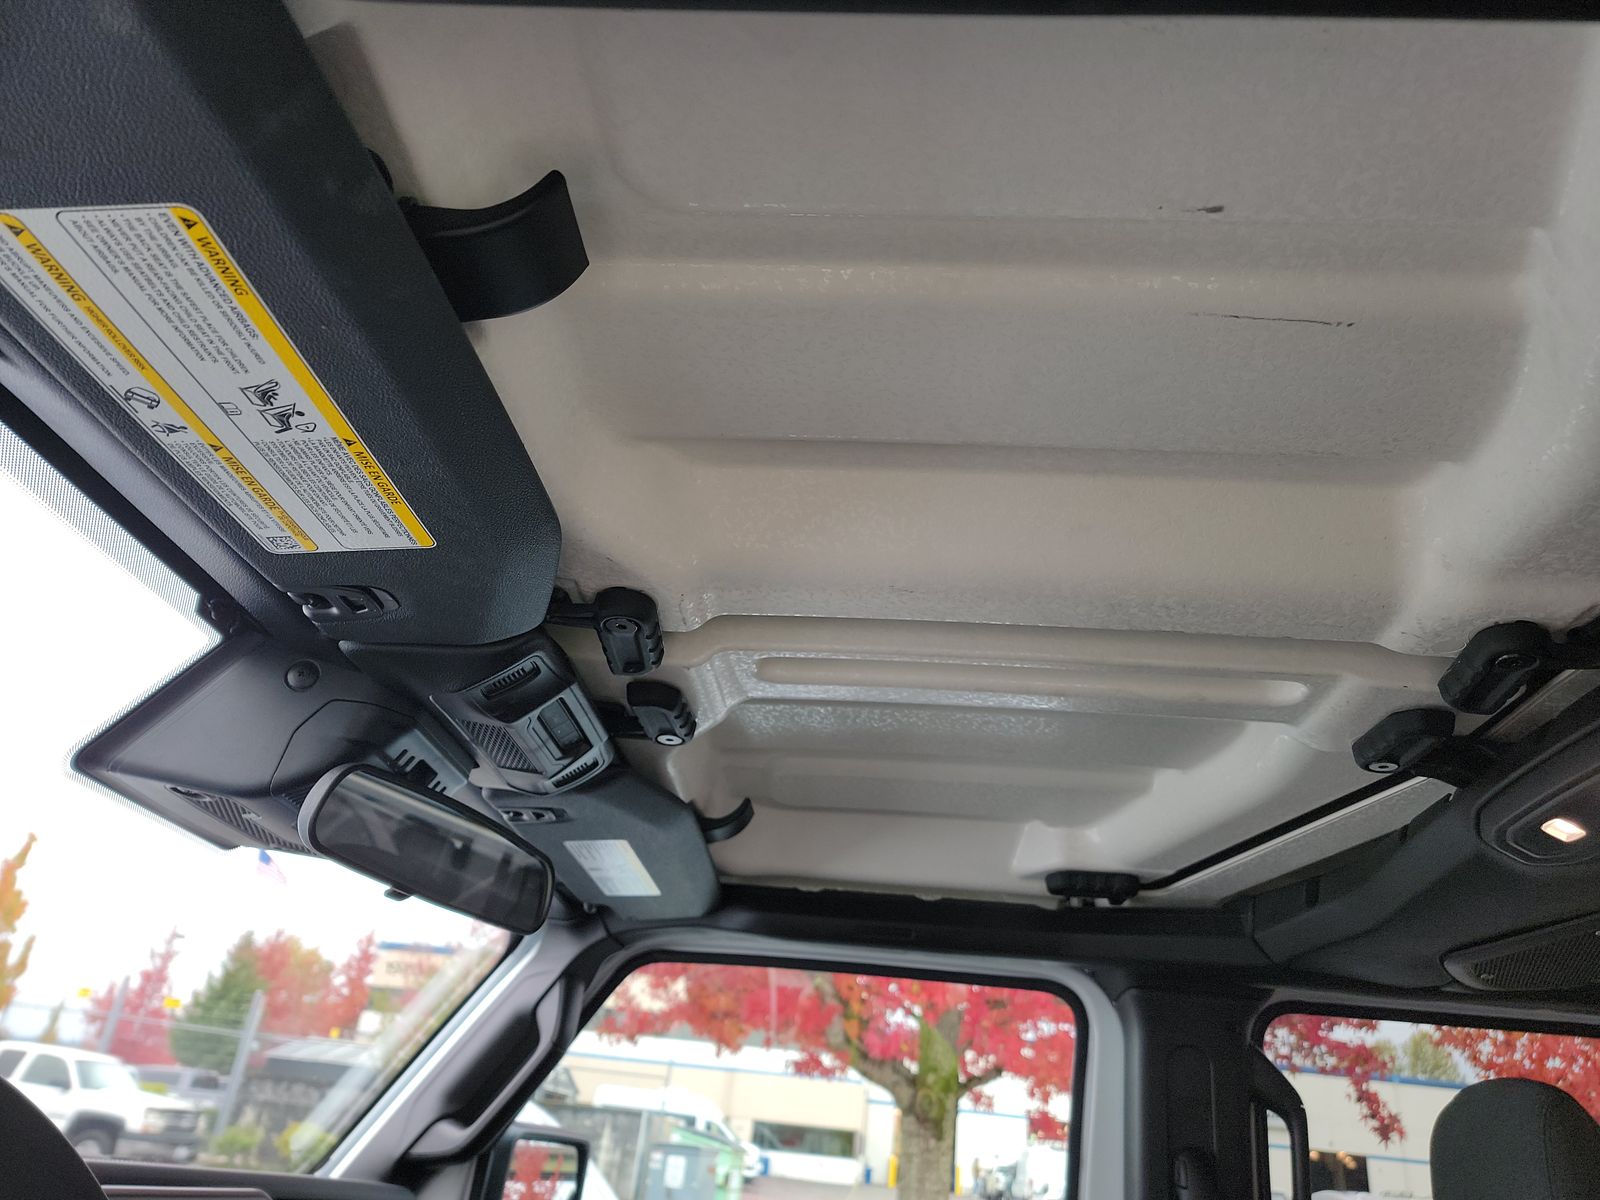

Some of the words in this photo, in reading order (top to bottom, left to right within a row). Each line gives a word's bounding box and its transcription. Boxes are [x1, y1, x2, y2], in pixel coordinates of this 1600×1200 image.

[68, 219, 95, 242] ABOUT
[132, 216, 147, 226] BY
[140, 227, 160, 241] THE
[155, 211, 183, 235] EVEN
[174, 235, 202, 260] WITH
[192, 260, 235, 304] ADVANCED
[0, 253, 33, 280] BUCKLE
[22, 242, 89, 301] WARNING
[81, 219, 100, 233] SEE
[120, 265, 149, 291] MANUAL
[142, 292, 161, 306] FOR
[154, 306, 176, 323] MORE
[169, 324, 208, 361] INFORMATION
[93, 218, 123, 245] ALWAYS
[116, 245, 135, 260] USE
[128, 261, 166, 297] SEATBELTS
[158, 297, 177, 310] AND
[170, 310, 192, 328] CHILD
[106, 218, 133, 242] NEVER
[126, 242, 145, 256] PUT
[177, 304, 199, 323] CHILD
[192, 323, 212, 338] SEAT
[210, 344, 226, 355] THE
[119, 217, 138, 231] THE
[131, 232, 154, 251] BACK
[146, 251, 168, 269] SEAT
[160, 269, 174, 277] IS
[167, 277, 185, 290] THE
[178, 290, 204, 314] SAFEST
[197, 315, 220, 334] PLACE
[213, 334, 230, 346] FOR
[144, 215, 179, 251] CHILDREN
[172, 251, 191, 266] CAN
[184, 266, 199, 276] BE
[209, 299, 224, 309] OR
[241, 340, 267, 364] INJURED
[194, 236, 250, 296] WARNING
[4, 246, 36, 273] ABRUPT
[30, 273, 73, 312] MANEUVERS
[66, 312, 85, 325] AND
[79, 325, 114, 356] EXCESSIVE
[8, 272, 39, 298] MANUAL
[33, 299, 54, 312] FOR
[47, 312, 79, 339] FURTHER
[221, 456, 247, 474] MISE
[239, 476, 257, 485] EN
[250, 487, 280, 510] GARDE
[352, 451, 376, 469] MISE
[367, 470, 384, 480] EN
[375, 481, 402, 505] GARDE
